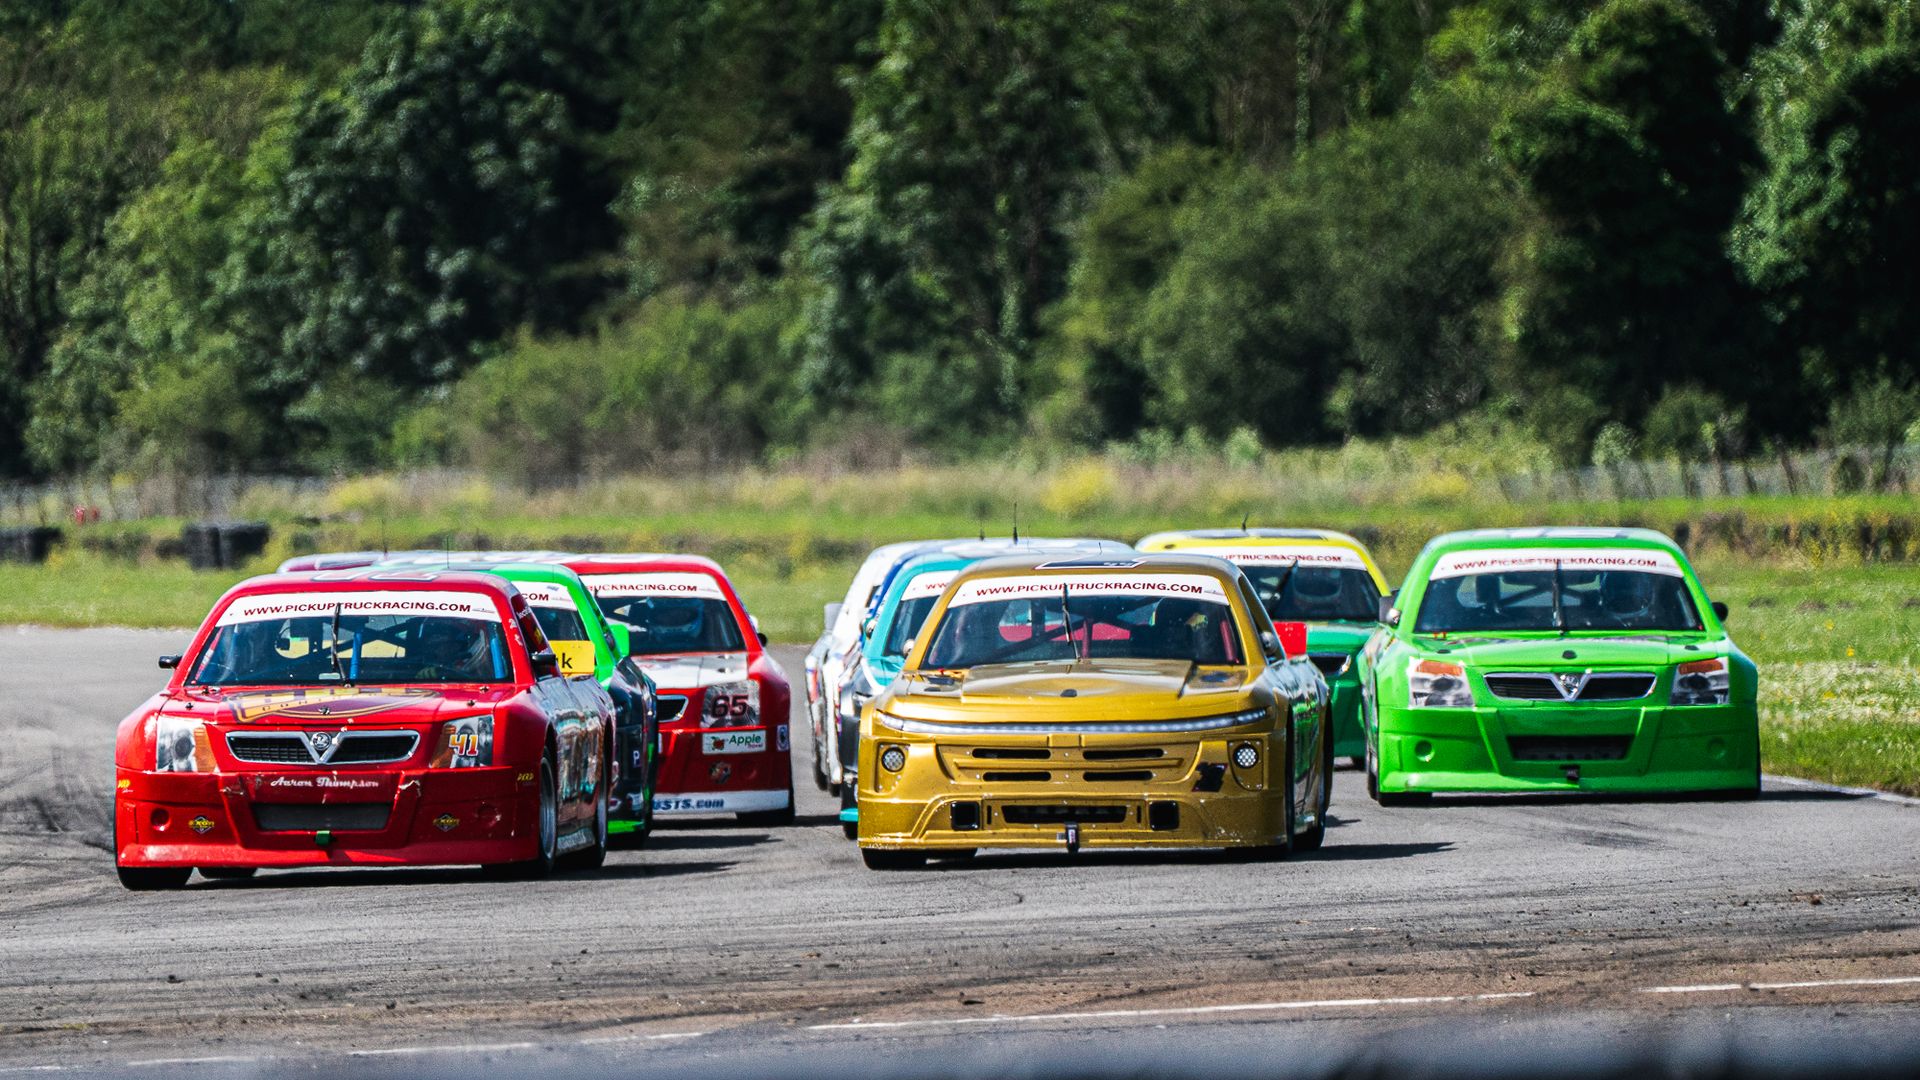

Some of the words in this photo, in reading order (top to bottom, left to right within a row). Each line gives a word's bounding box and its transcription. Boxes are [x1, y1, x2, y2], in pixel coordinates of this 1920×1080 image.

[976, 582, 1203, 597] WWW.PICKUPTRUCKRACING.COM
[244, 601, 471, 616] WWW.PICKUPTRUCKRACING.COM
[711, 694, 748, 717] 65
[449, 733, 479, 756] 41
[728, 734, 762, 746] Apple
[270, 776, 313, 787] Aaron
[316, 776, 379, 789] Thompson
